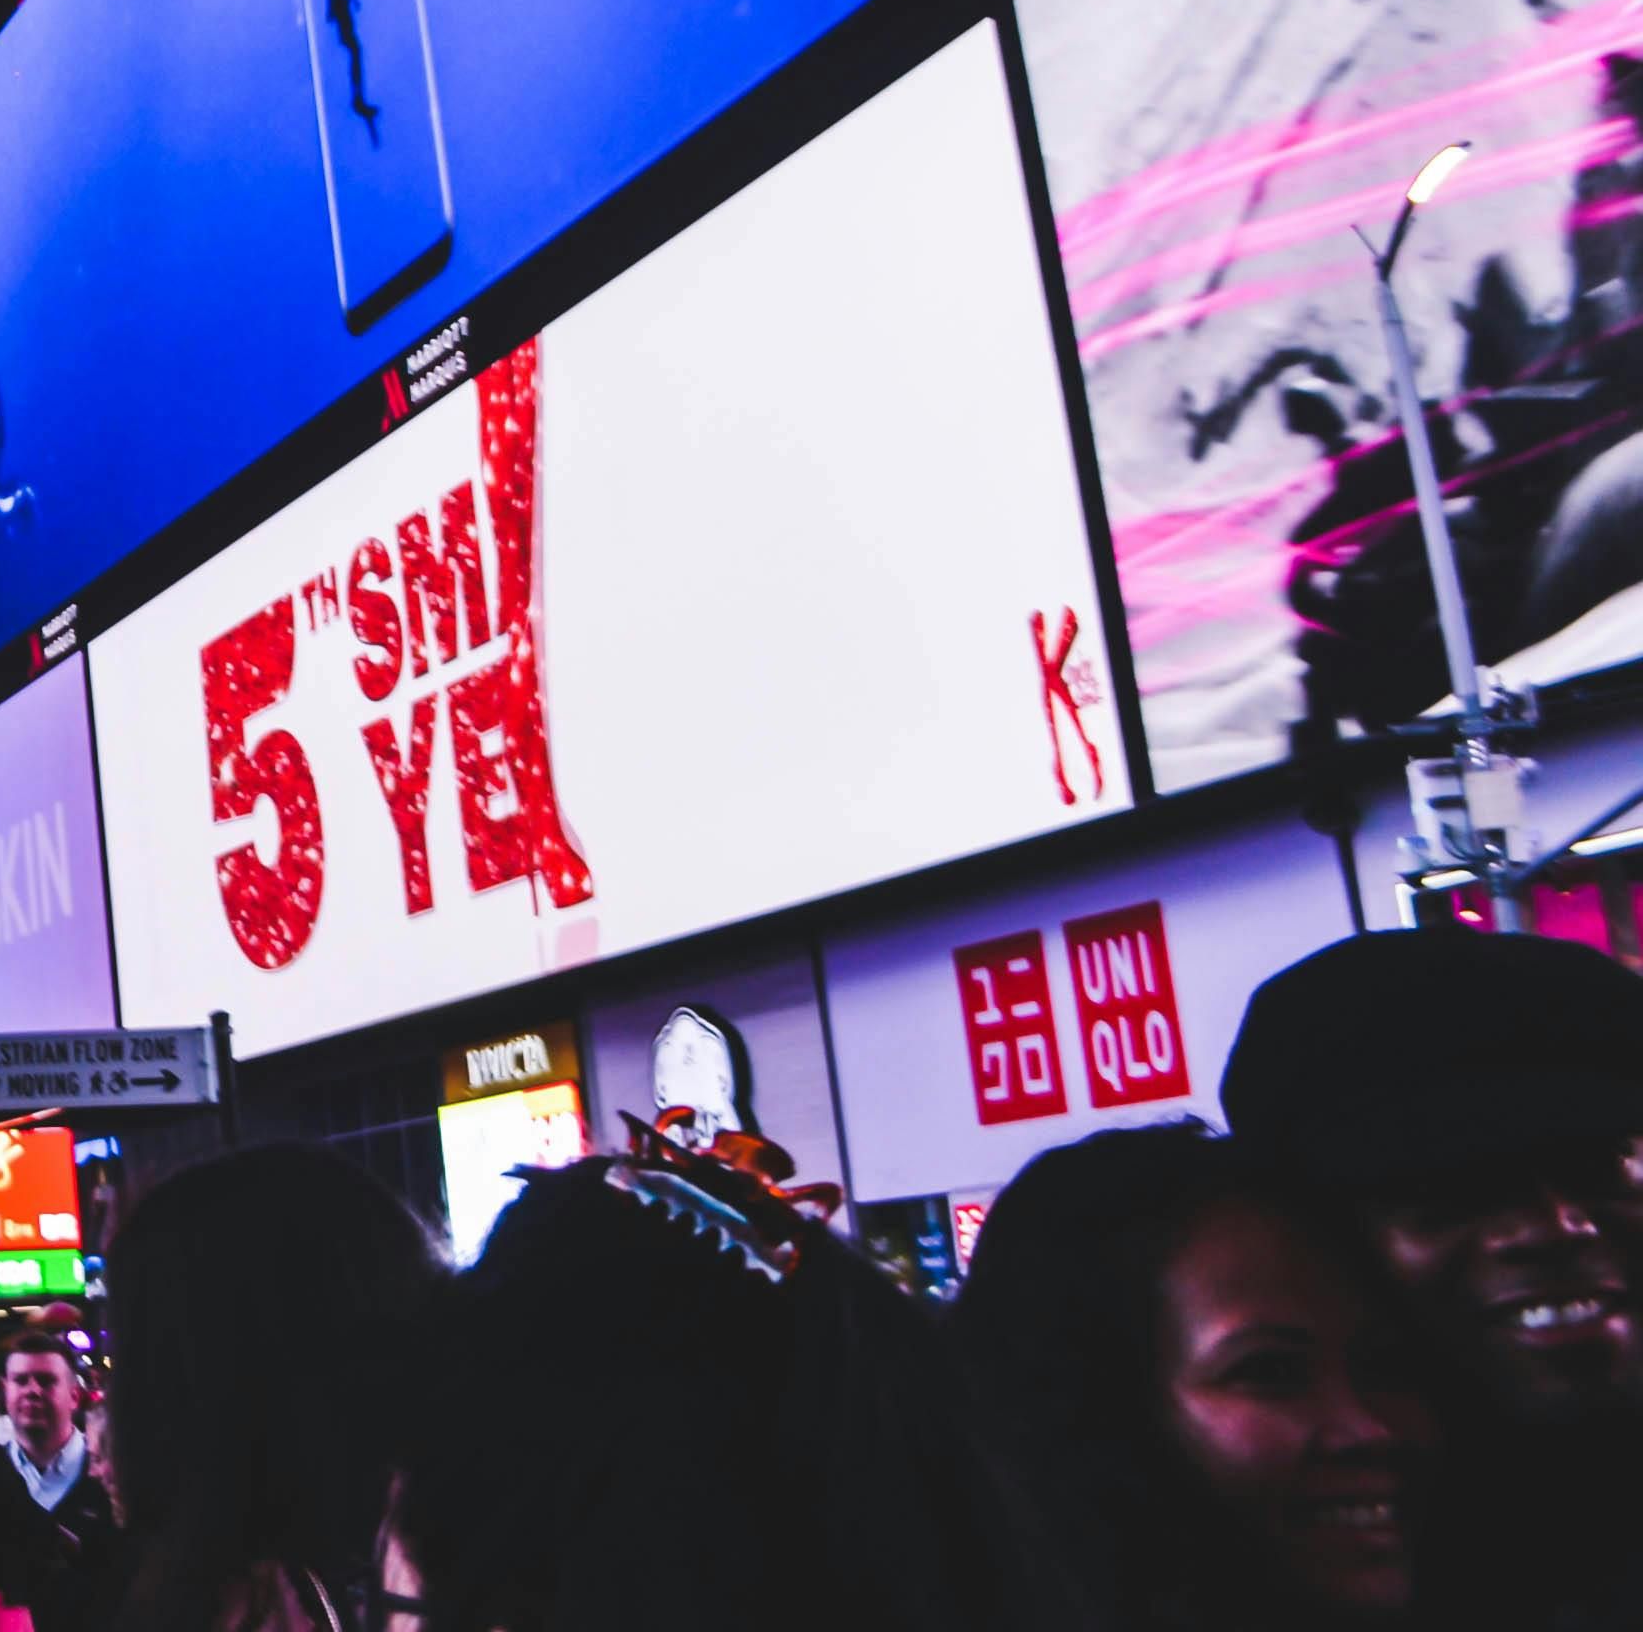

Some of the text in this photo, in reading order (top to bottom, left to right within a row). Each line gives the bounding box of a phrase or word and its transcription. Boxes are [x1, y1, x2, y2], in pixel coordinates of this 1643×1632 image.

[1078, 931, 1155, 1005] UNI
[74, 1038, 125, 1063] FLOW
[130, 1036, 179, 1061] ZONE
[1092, 1010, 1173, 1093] QLO
[7, 1070, 81, 1097] MOVING
